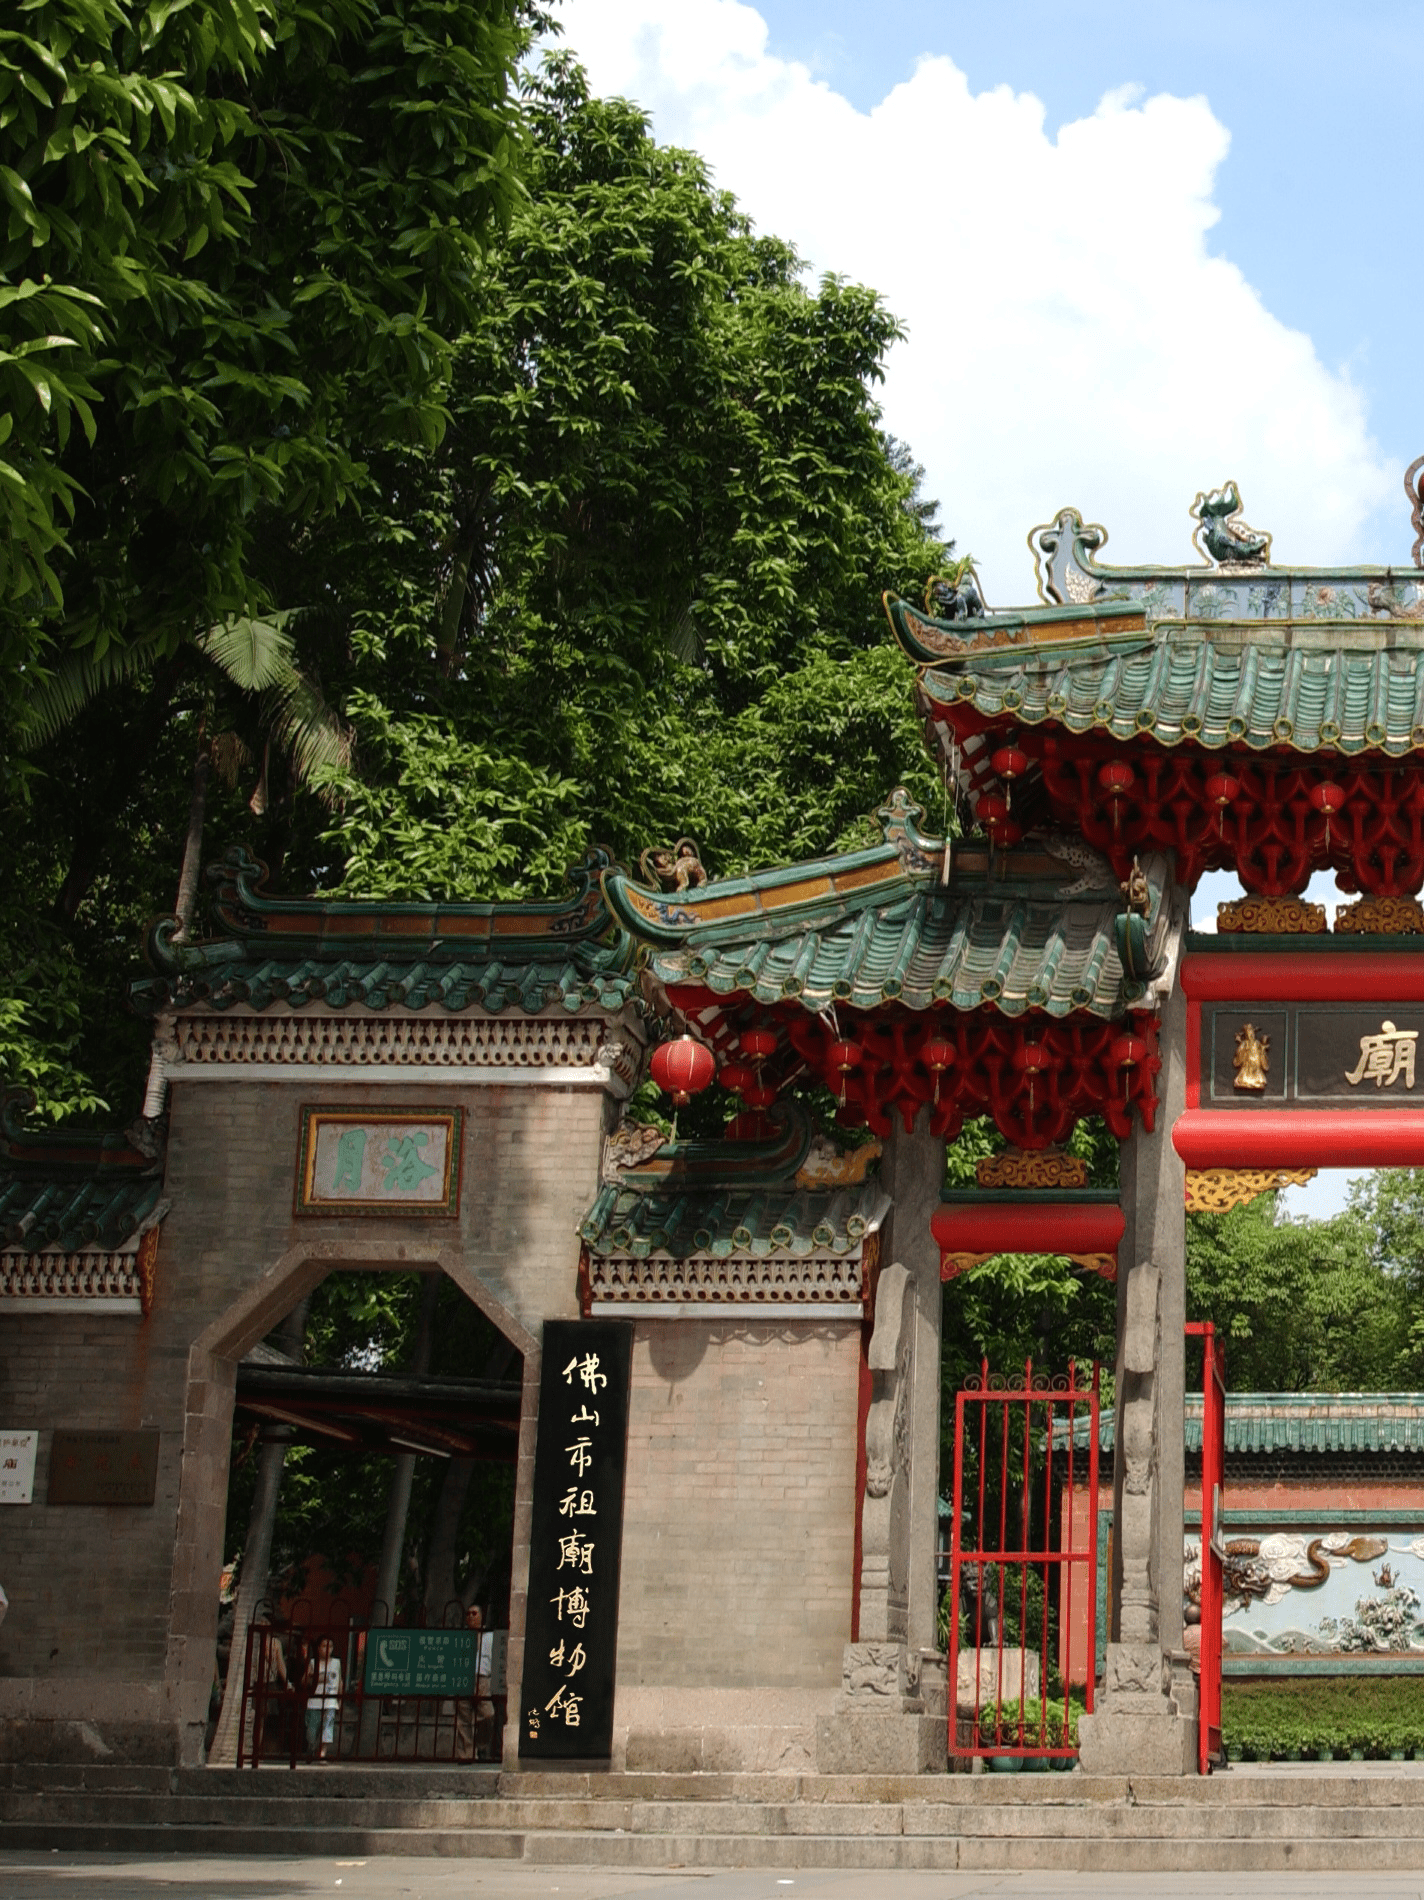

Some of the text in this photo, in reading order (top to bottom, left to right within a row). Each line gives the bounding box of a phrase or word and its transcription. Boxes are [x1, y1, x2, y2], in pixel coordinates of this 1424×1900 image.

[454, 1637, 471, 1649] 110
[453, 1657, 470, 1668] 119
[451, 1676, 469, 1688] 120
